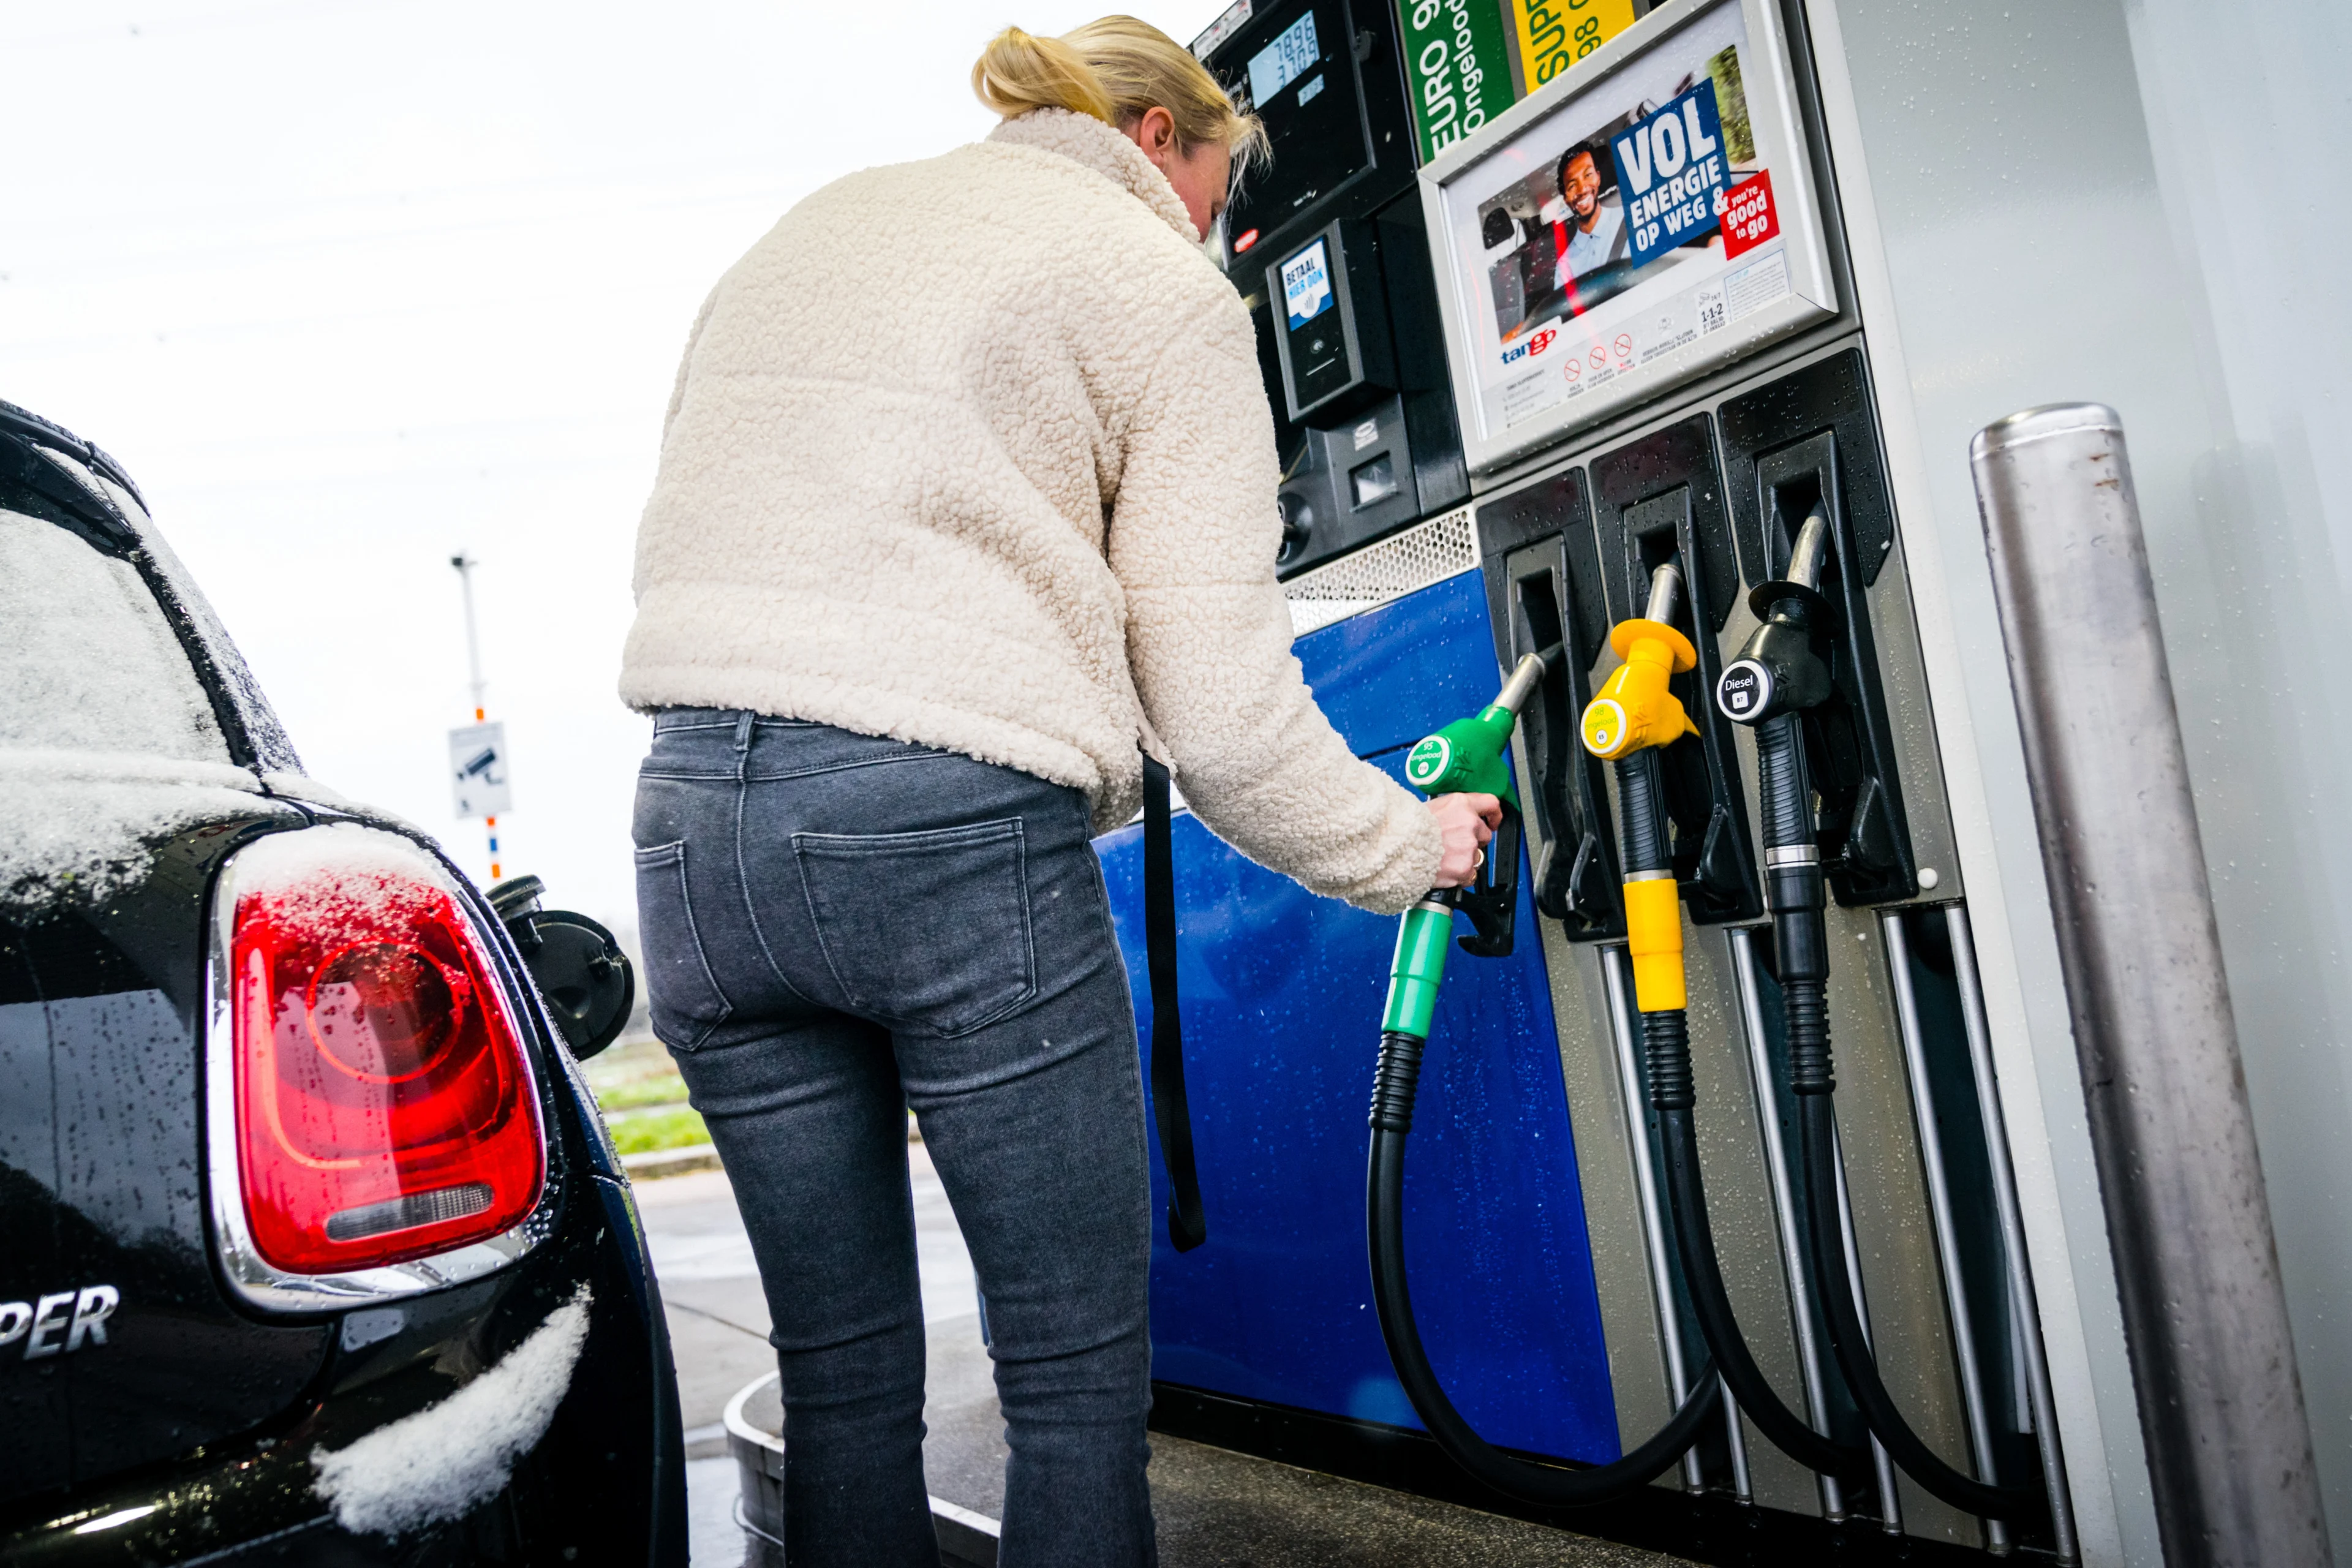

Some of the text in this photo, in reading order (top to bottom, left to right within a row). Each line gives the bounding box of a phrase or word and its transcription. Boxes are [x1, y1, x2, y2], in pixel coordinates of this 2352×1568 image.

[1574, 16, 1602, 59] 98
[1410, 0, 1461, 159] EURO 9
[1617, 96, 1716, 196] VOL
[1630, 155, 1722, 229] ENERGIE
[1731, 186, 1758, 208] you're
[1635, 186, 1730, 252] OP WEG &
[1727, 189, 1768, 230] good
[1736, 215, 1768, 240] to go
[1286, 257, 1316, 287] BETAAL
[1287, 268, 1324, 300] HIER OOK
[1701, 303, 1724, 323] 1-1-2
[1501, 328, 1557, 365] tango
[1725, 674, 1753, 691] Diesel
[1585, 716, 1617, 731] ongelood
[1594, 707, 1605, 717] 98
[1411, 750, 1442, 762] ongelood
[1423, 742, 1434, 751] 95
